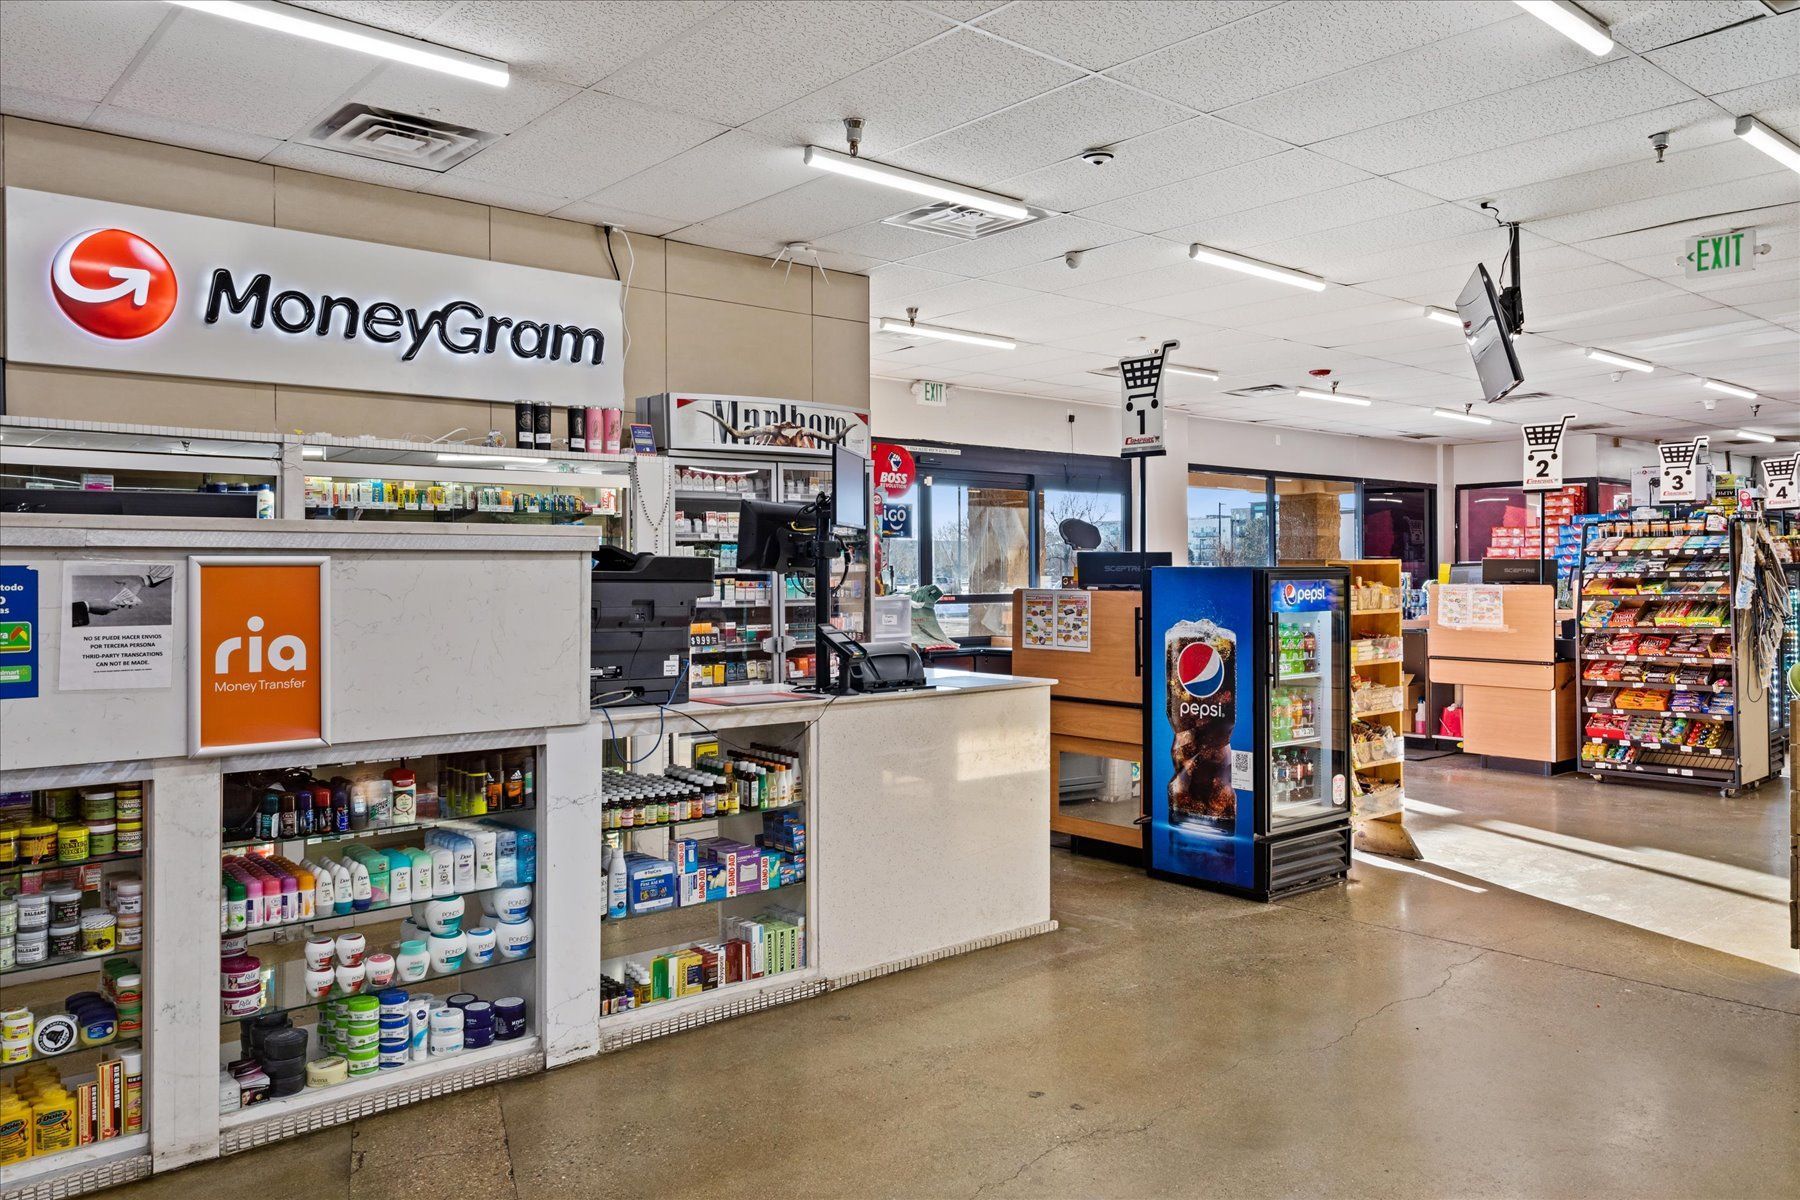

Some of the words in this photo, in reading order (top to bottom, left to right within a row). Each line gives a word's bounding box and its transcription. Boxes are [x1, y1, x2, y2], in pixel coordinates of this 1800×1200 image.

[1696, 233, 1744, 272] EXIT
[204, 267, 605, 365] MoneyGram
[924, 381, 943, 402] EXIT
[1137, 410, 1145, 434] 1
[1536, 460, 1549, 477] 2
[880, 472, 908, 483] BOSS
[1672, 475, 1683, 490] 3
[1776, 486, 1788, 499] 4
[1297, 587, 1326, 604] pepsi
[215, 616, 307, 674] ria
[214, 681, 257, 693] Money
[258, 678, 307, 691] Transfer
[1180, 702, 1222, 719] pepsi
